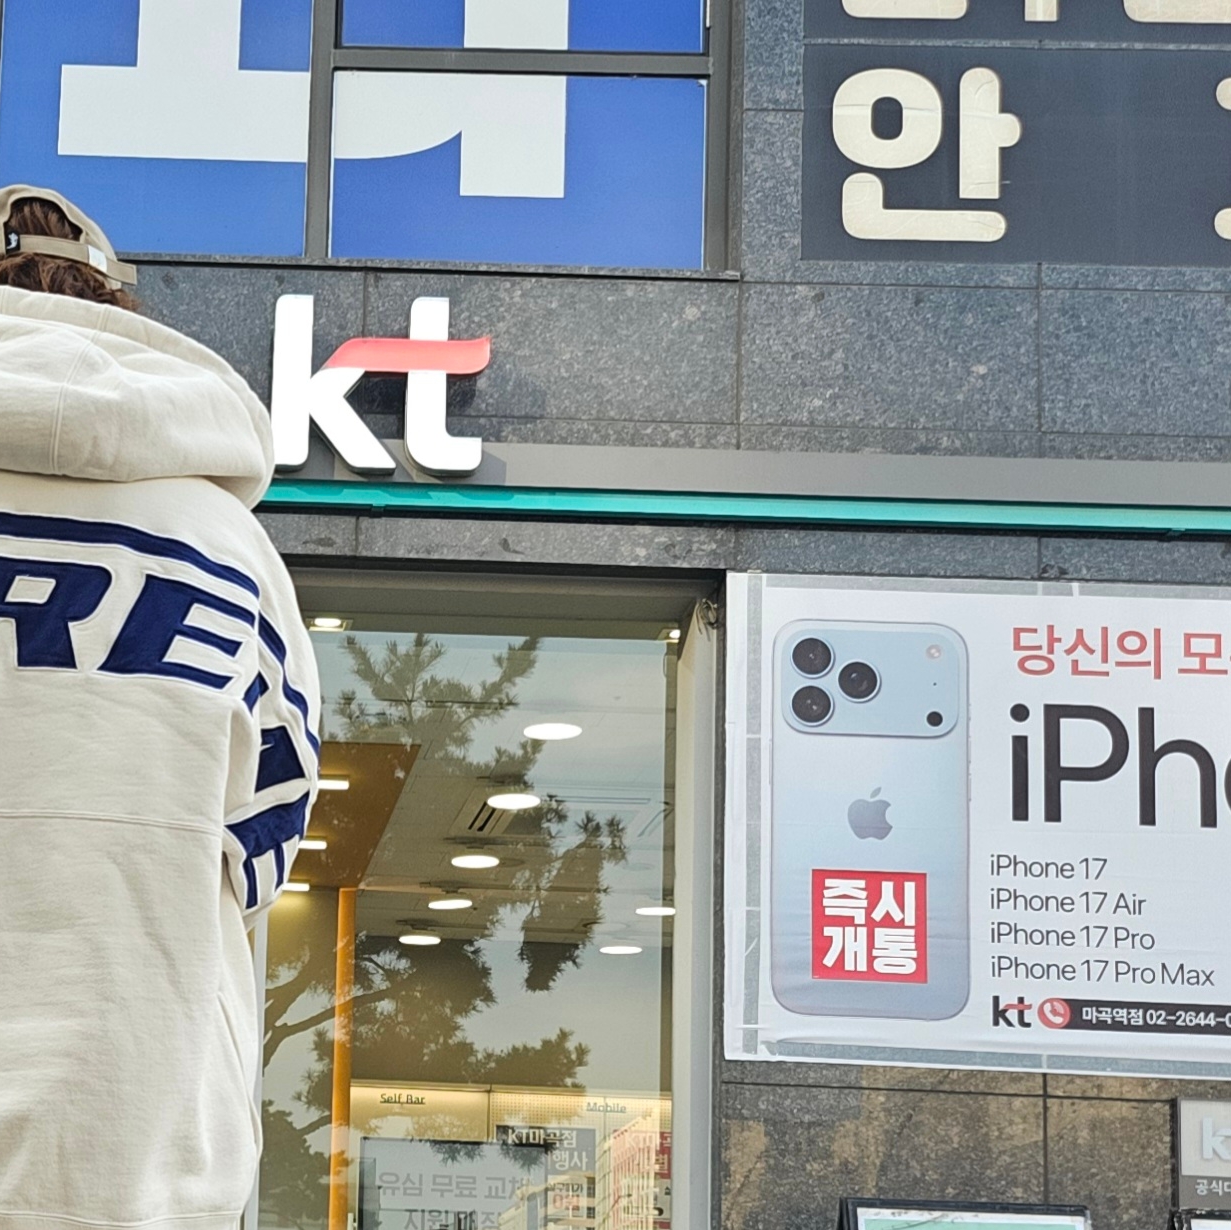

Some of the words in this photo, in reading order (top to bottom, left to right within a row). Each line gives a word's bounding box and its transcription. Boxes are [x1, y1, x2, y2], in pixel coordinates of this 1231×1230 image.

[832, 67, 1022, 242] 안
[270, 293, 491, 473] kt
[1011, 624, 1163, 680] 당신의
[1176, 631, 1231, 679] 모
[1009, 703, 1231, 829] iPh
[990, 854, 1075, 879] iPhone
[1078, 857, 1108, 881] 17
[821, 878, 917, 927] 즉시
[990, 888, 1075, 913] iPhone
[1078, 891, 1108, 914] 17
[1112, 892, 1147, 916] Air
[821, 924, 919, 974] 개통
[990, 922, 1076, 947] iPhone
[1079, 925, 1109, 949] 17
[1113, 926, 1156, 951] Pro
[991, 956, 1077, 981] iPhone
[1080, 959, 1110, 983] 17
[1114, 960, 1157, 985] Pro
[1160, 962, 1216, 987] Max
[991, 995, 1033, 1029] kt
[1082, 1006, 1144, 1026] 마곡역점
[380, 1093, 403, 1105] Self
[406, 1094, 426, 1105] Bar
[586, 1102, 627, 1114] Mobile
[547, 1151, 589, 1171] 행사
[379, 1172, 423, 1197] 유심
[431, 1173, 477, 1199] 무료
